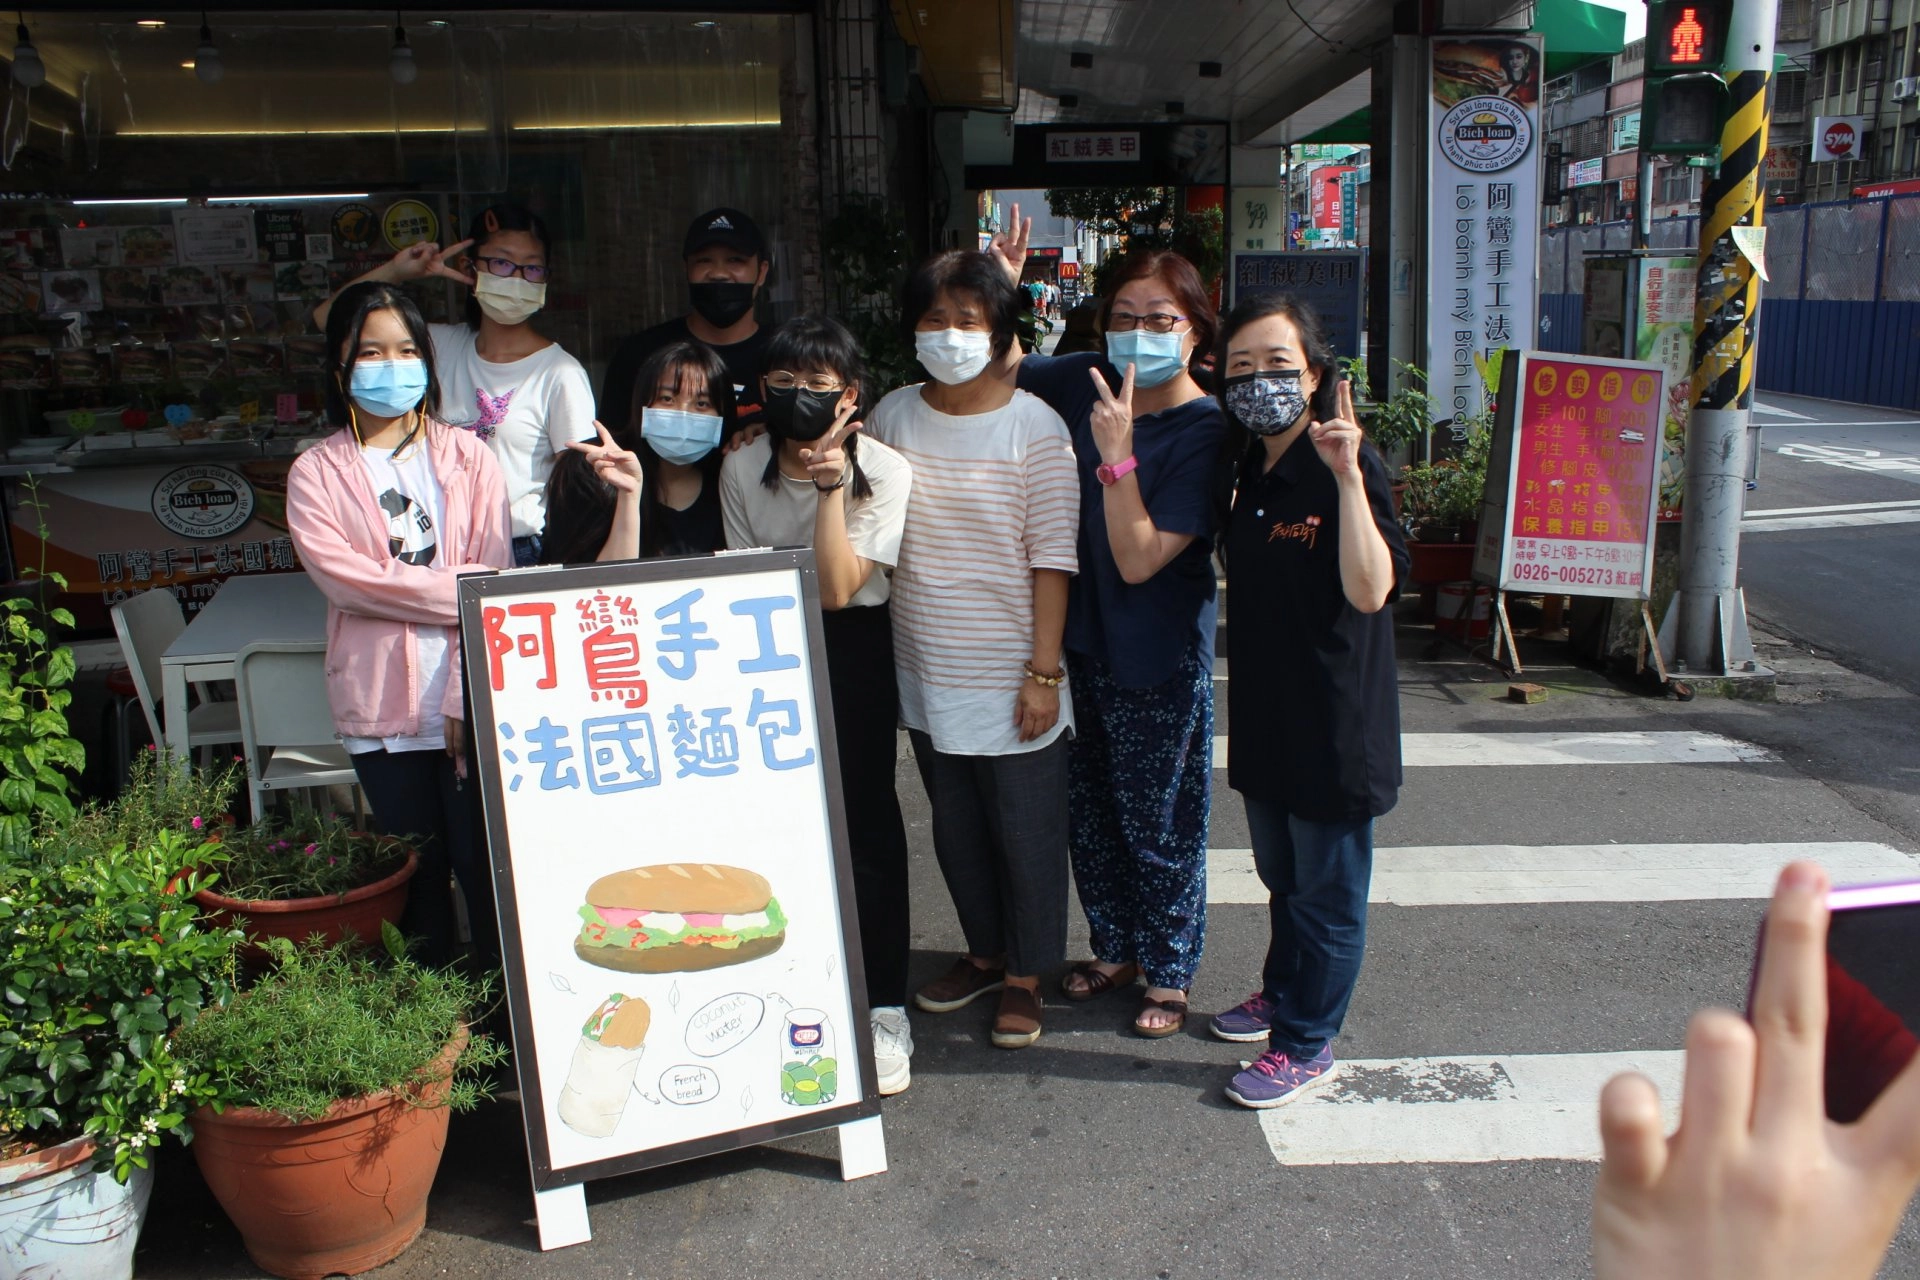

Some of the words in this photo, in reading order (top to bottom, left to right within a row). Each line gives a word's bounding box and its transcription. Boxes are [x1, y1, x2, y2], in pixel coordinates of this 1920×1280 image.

[1487, 127, 1511, 138] loan
[1824, 132, 1855, 148] SYM
[1051, 137, 1136, 158] 紅絨美甲
[1456, 185, 1476, 210] Lò
[266, 213, 290, 223] Uber
[1455, 218, 1475, 279] bánh
[1239, 259, 1354, 289] 紅絨美甲
[1646, 267, 1663, 324] 自行車安全
[1454, 330, 1474, 377] Bích
[1539, 373, 1650, 400] 修剪指甲
[1452, 385, 1471, 441] Loan
[1536, 403, 1552, 419] 手
[1562, 406, 1586, 422] 100
[1534, 423, 1567, 438] 女生
[1533, 441, 1563, 456] 男生
[205, 493, 233, 505] loan
[416, 515, 433, 533] 10
[1522, 516, 1609, 537] 保養指甲
[96, 539, 295, 584] 阿鸞手工法國麵
[1513, 563, 1613, 585] 0926-005273
[1616, 570, 1642, 586] 紅絨
[482, 588, 801, 707] 阿鸞手工
[500, 688, 815, 795] 法國麵包
[693, 994, 747, 1030] coconut
[705, 1014, 744, 1043] water
[674, 1070, 707, 1087] French
[676, 1084, 703, 1100] bread
